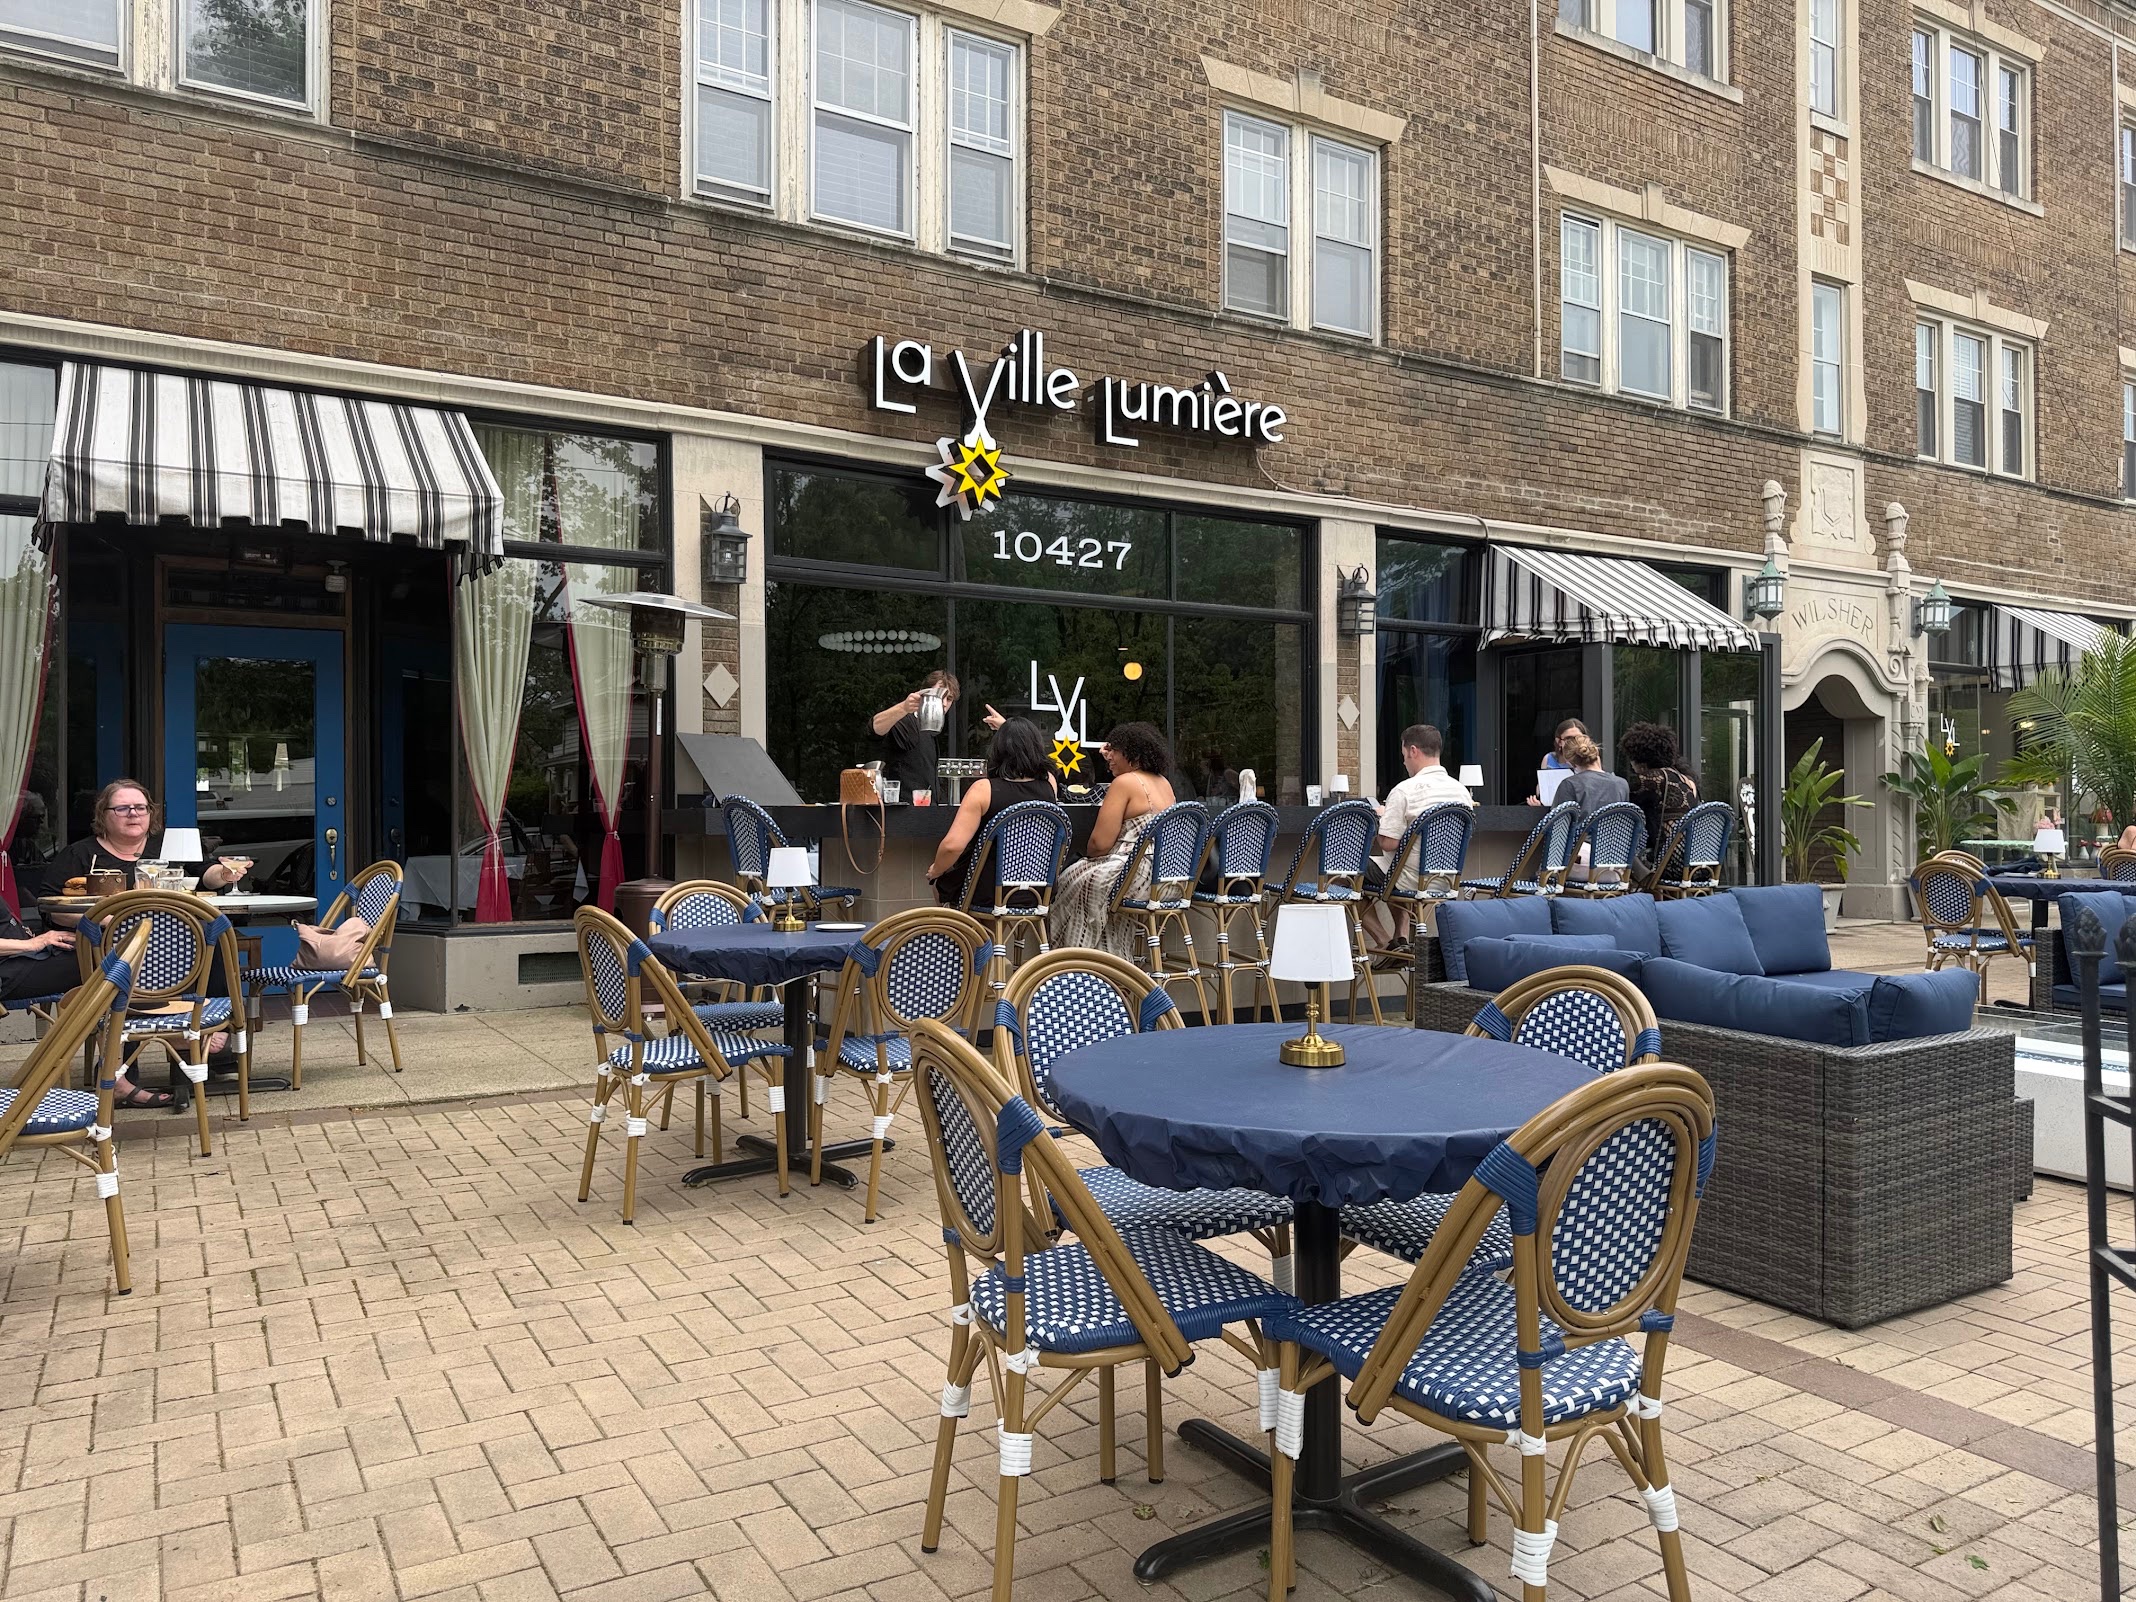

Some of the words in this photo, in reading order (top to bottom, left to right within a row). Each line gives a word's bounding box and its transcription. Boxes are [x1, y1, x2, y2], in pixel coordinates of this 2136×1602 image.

[876, 335, 932, 414] La
[945, 328, 1080, 448] Ville
[1105, 370, 1287, 447] Lumière
[993, 530, 1132, 571] 10427
[1791, 597, 1875, 643] WILSHER
[1031, 660, 1108, 749] LVL
